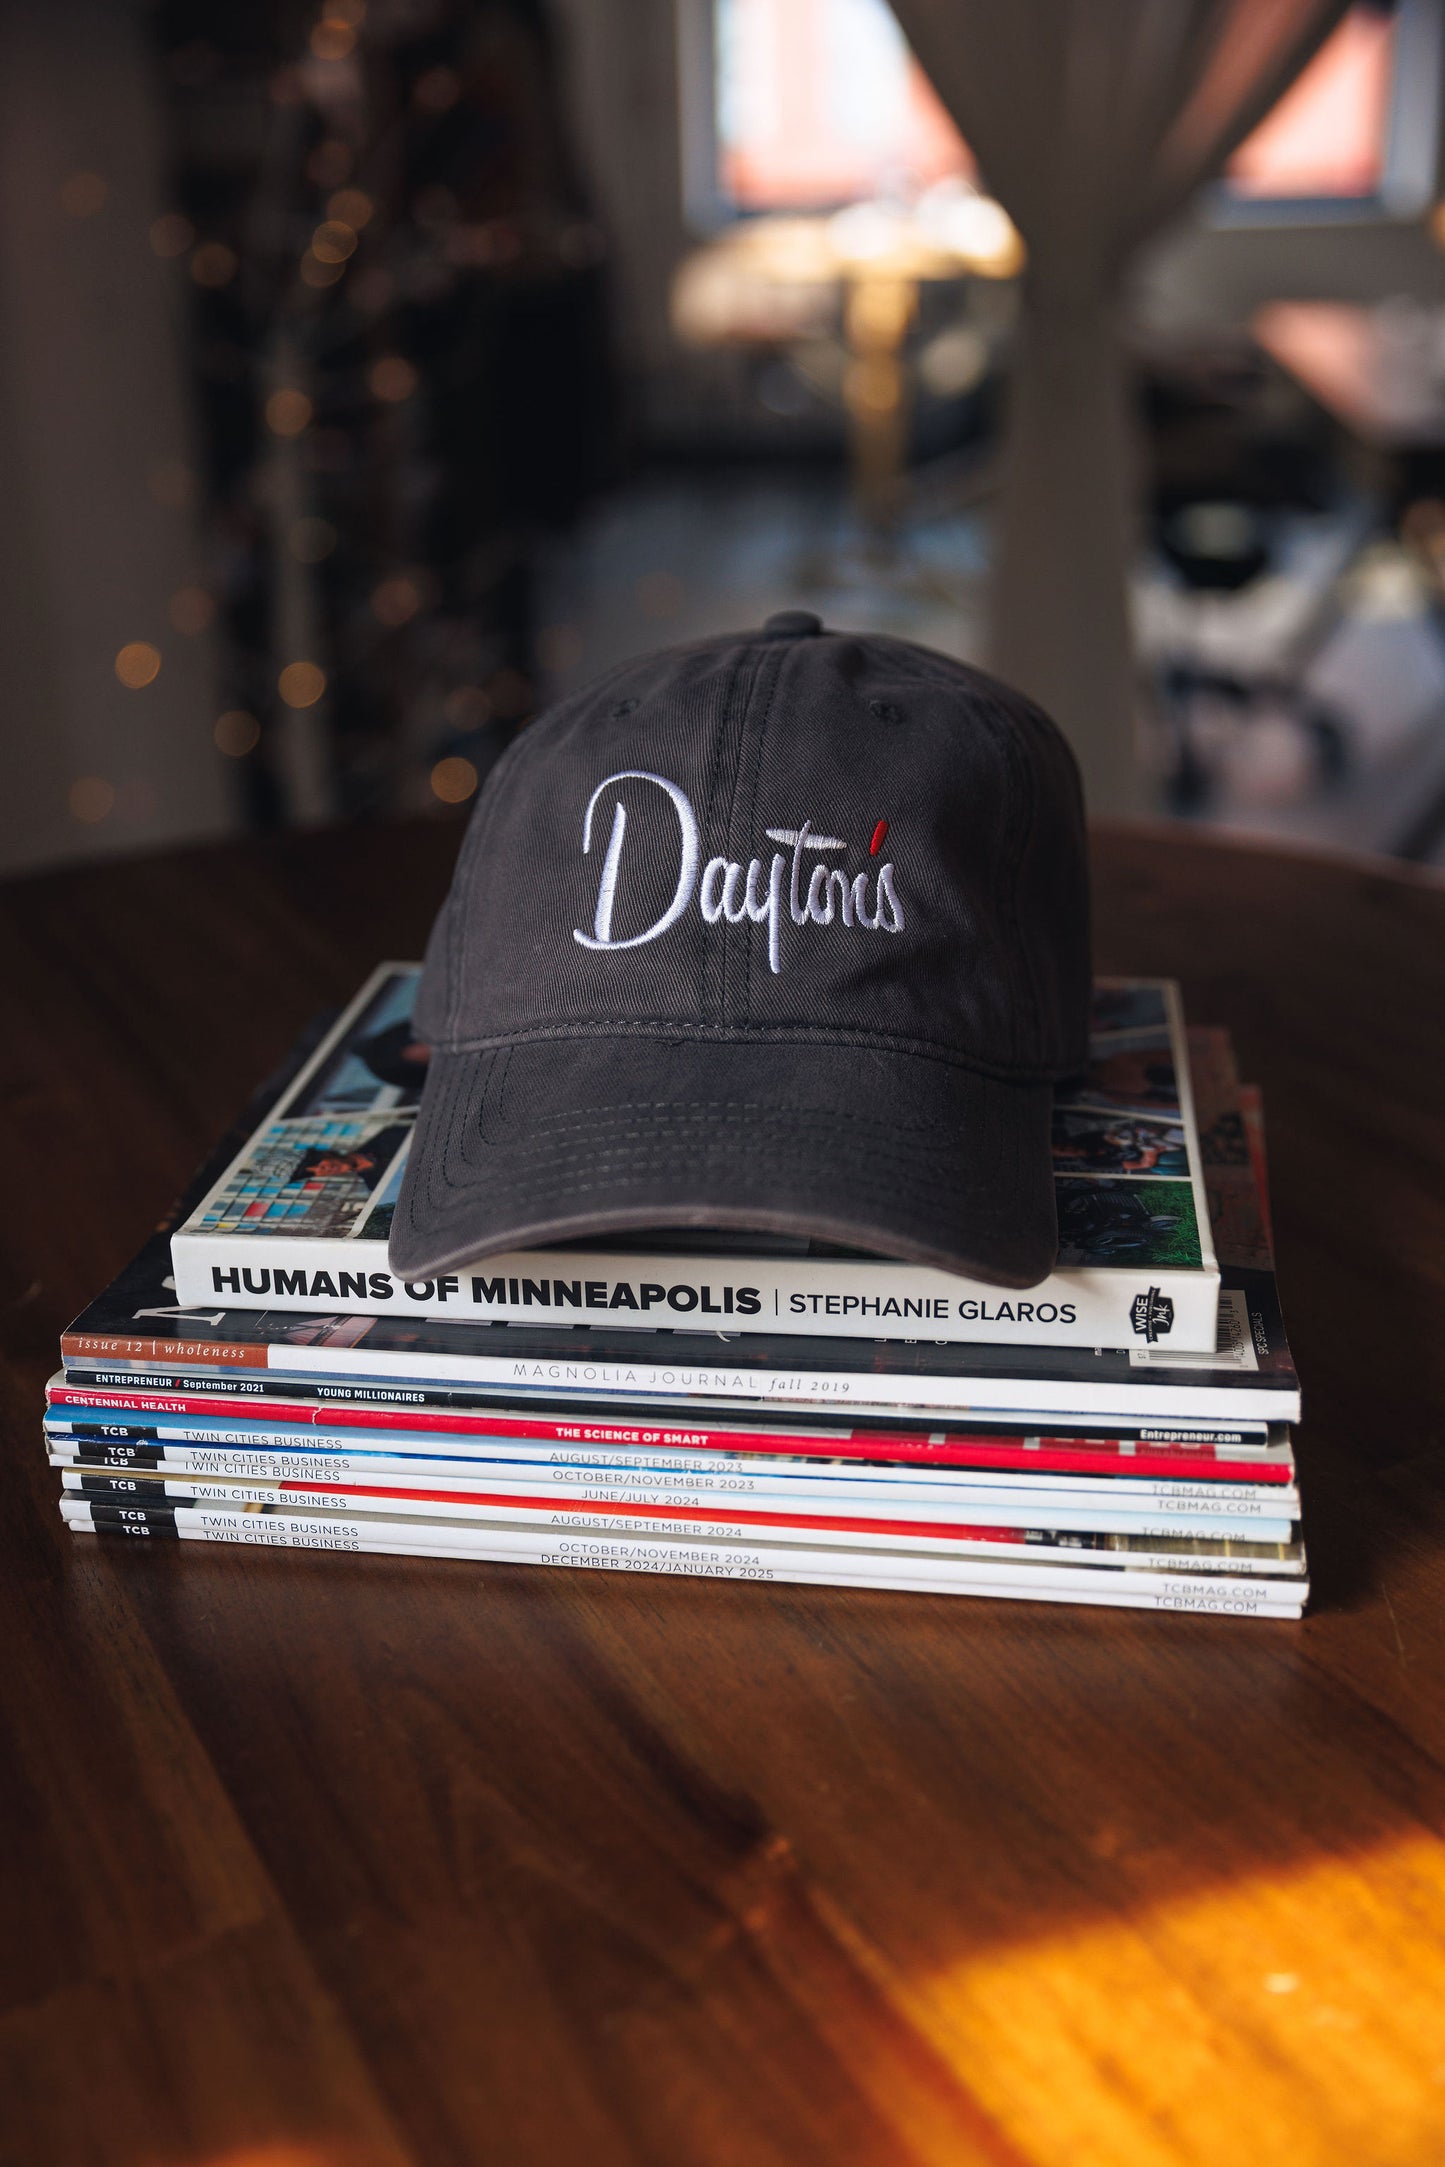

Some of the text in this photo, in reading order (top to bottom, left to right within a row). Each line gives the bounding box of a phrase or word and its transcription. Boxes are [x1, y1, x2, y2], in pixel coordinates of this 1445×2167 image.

[573, 770, 905, 973] Dayton's
[211, 1267, 762, 1315] HUMANS OF MINNEAPOLIS
[789, 1294, 1077, 1323] STEPHANIE GLAROS
[1135, 1297, 1148, 1331] WISE
[1251, 1312, 1269, 1355] SPC SPECIALS
[78, 1337, 246, 1359] issue 12 wholeness
[96, 1374, 264, 1392] ENTREPRENEUR September 2021
[513, 1364, 850, 1393] MAGNOLIA JOURNAL fall 2019
[65, 1395, 186, 1412] CENTENNIAL HEALTH
[317, 1387, 425, 1402] YOUNG MILLIONAIRES
[101, 1426, 129, 1436] TCB
[183, 1431, 342, 1449] TWIN CITIES BUSINESS
[556, 1427, 709, 1445] THE SCIENCE OF SMART
[1140, 1429, 1241, 1443] Entrepreneur.com
[108, 1447, 136, 1457] TCB
[191, 1451, 350, 1468] TWIN CITIES BUSINESS
[104, 1457, 129, 1466] TCB
[549, 1452, 743, 1472] AUGUST/SEPTEMBER 2023
[185, 1461, 340, 1481] TWIN CITIES BUSINESS
[552, 1470, 754, 1490] OCTOBER/NOVEMBER 2023
[110, 1480, 137, 1491] TCB
[191, 1486, 347, 1508] TWIN CITIES BUSINESS
[581, 1489, 700, 1506] JUNE/JULY 2024
[1157, 1499, 1261, 1513] TCBMAG.COM
[119, 1510, 146, 1521] TCB
[123, 1525, 150, 1535] TCB
[201, 1516, 359, 1537] TWIN CITIES BUSINESS
[551, 1514, 742, 1537] AUGUST/SEPTEMBER 2024
[203, 1531, 360, 1550] TWIN CITIES BUSINESS
[559, 1542, 760, 1565] OCTOBER/NOVEMBER 2024
[541, 1554, 774, 1579] DECEMBER 2024/JANUARY 2025
[1148, 1558, 1253, 1572] TCBMAG.COM
[1163, 1582, 1267, 1598] TCBMAG.COM
[1154, 1596, 1258, 1612] TCBMAG.COM
